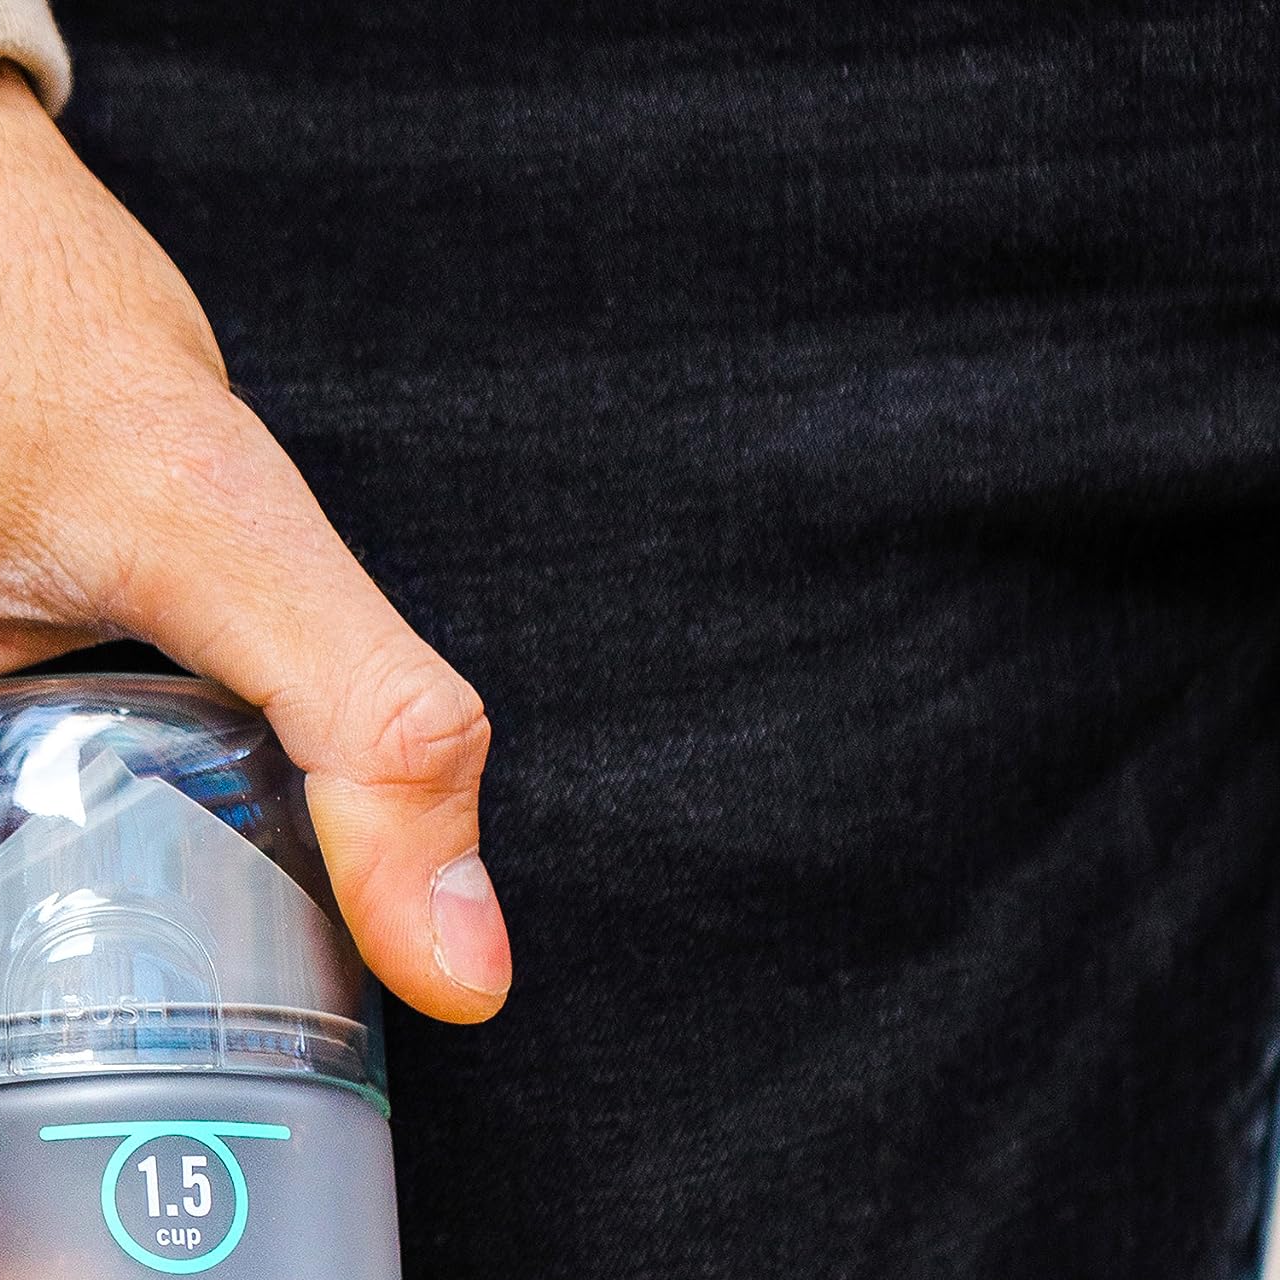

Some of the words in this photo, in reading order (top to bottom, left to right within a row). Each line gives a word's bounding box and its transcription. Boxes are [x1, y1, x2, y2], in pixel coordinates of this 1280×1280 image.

[62, 994, 173, 1026] PUSH
[137, 1155, 212, 1218] 1.5
[156, 1227, 202, 1250] cup
